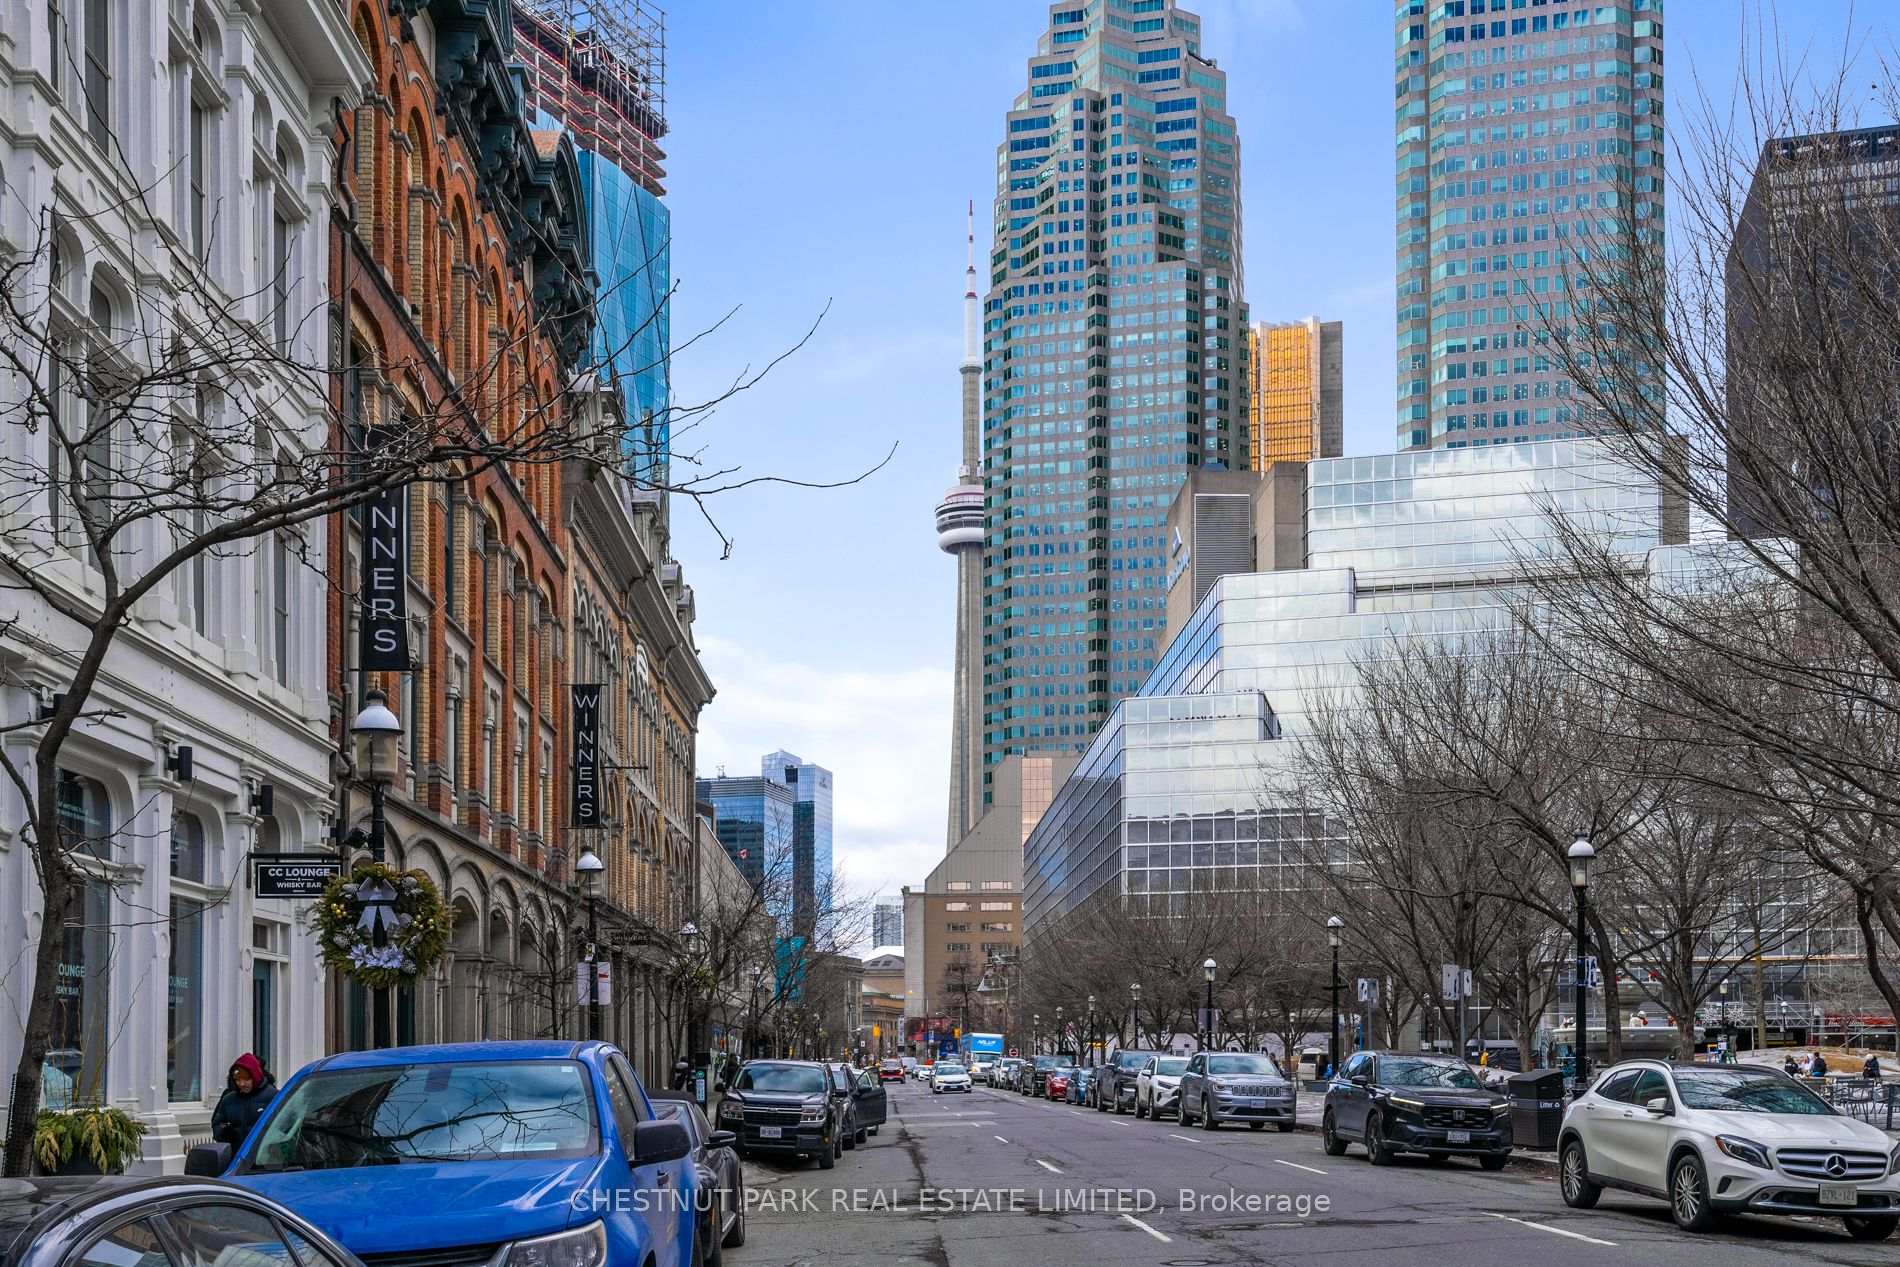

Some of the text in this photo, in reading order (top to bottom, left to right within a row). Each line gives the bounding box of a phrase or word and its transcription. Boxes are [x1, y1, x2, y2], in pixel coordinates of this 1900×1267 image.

[371, 490, 397, 652] NNERS
[574, 694, 598, 818] WINNERS
[268, 868, 330, 877] CC LOUNGE
[276, 881, 322, 889] WHISKY BAR
[58, 963, 86, 978] OUNGE
